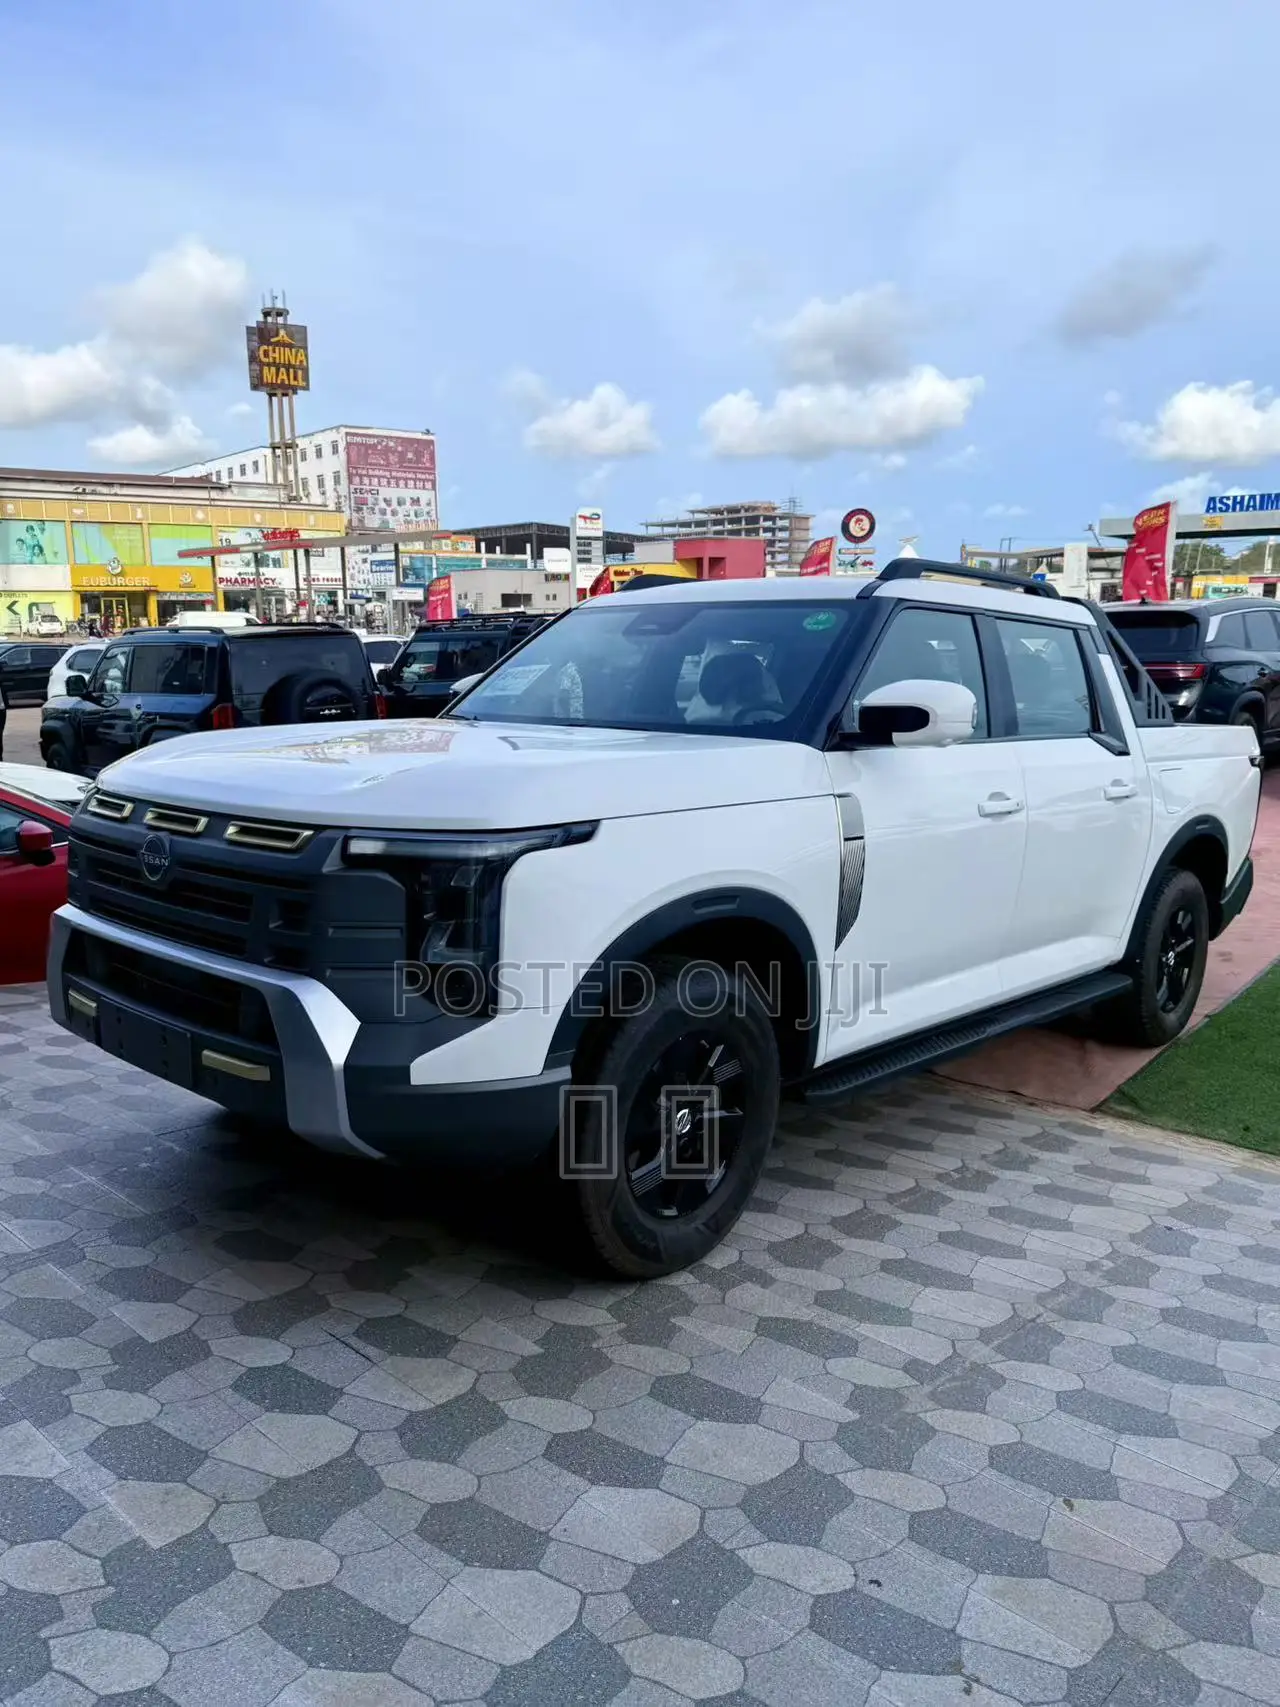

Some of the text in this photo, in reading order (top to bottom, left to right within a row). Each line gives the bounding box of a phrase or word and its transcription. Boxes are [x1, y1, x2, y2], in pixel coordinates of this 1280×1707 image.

[259, 345, 307, 366] CHINA
[263, 366, 306, 387] MALL
[1205, 492, 1280, 513] ASHAIM
[218, 577, 277, 587] PHARMACY
